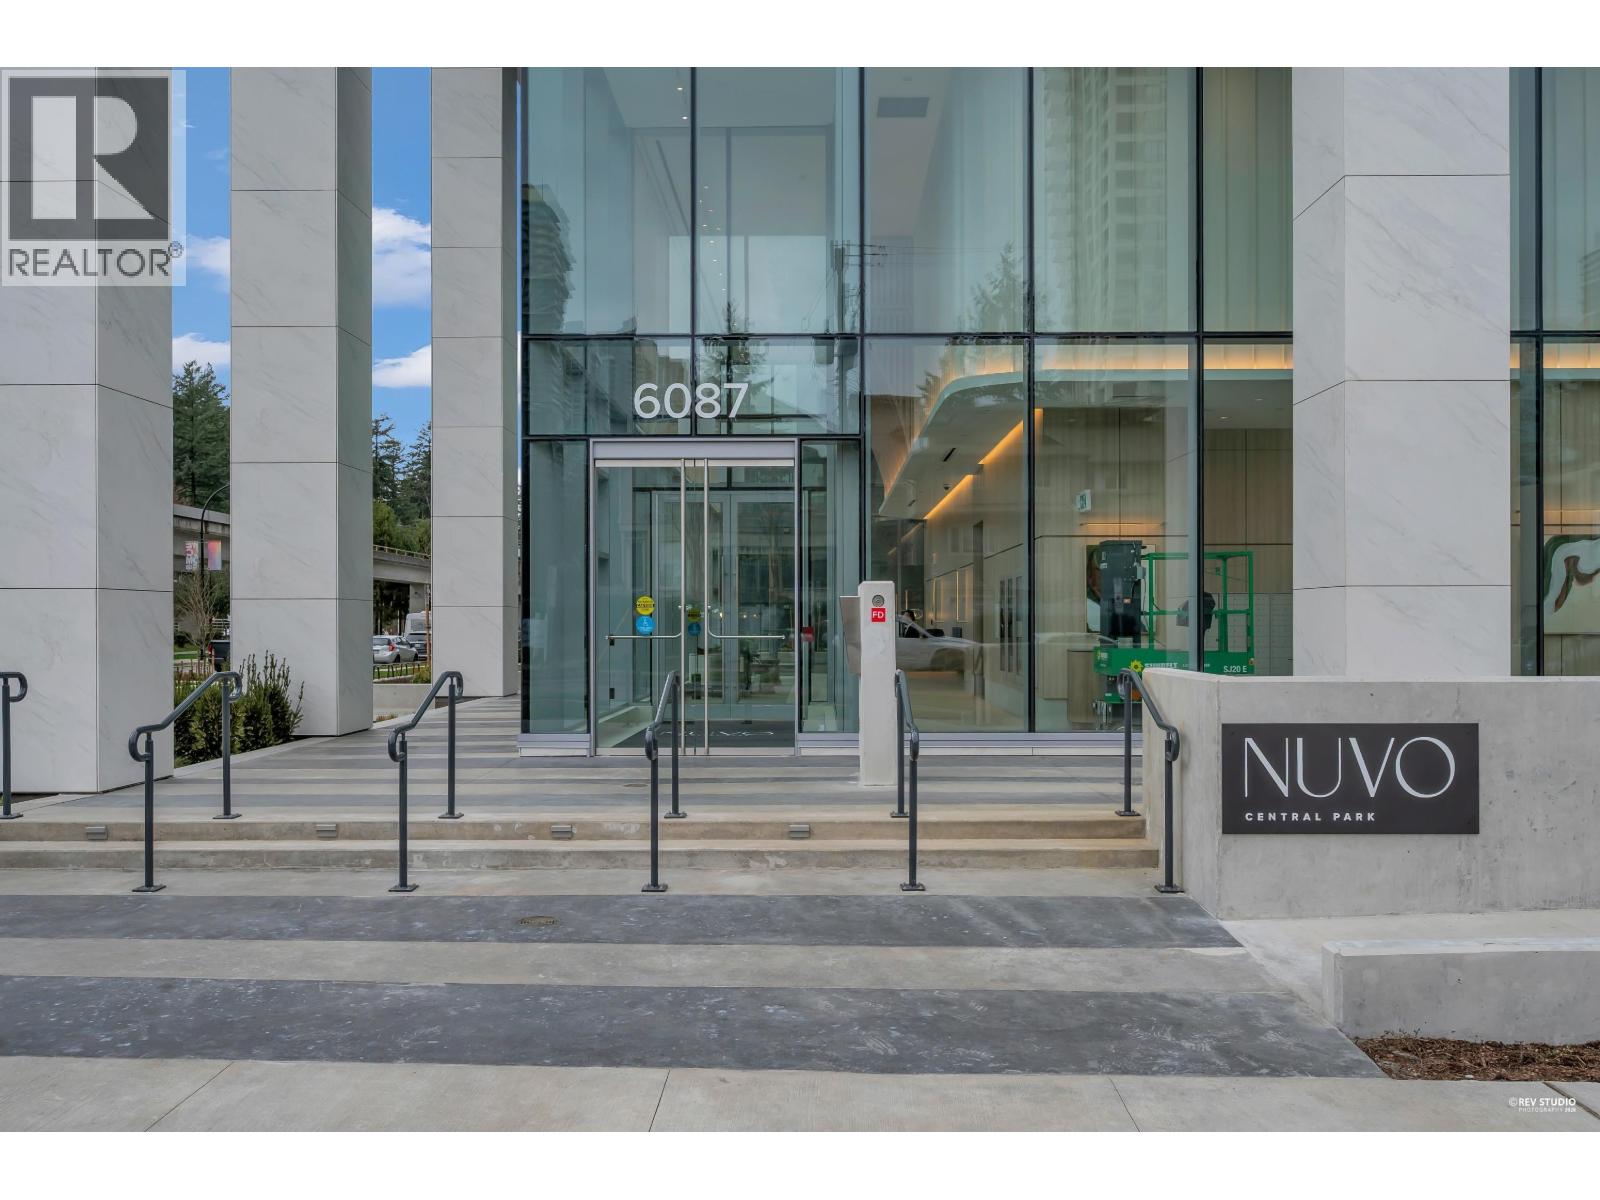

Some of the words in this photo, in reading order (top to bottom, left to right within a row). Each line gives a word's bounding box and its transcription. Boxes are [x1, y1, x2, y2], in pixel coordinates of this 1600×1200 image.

[634, 382, 749, 419] 6087
[872, 611, 885, 619] FD
[1223, 665, 1241, 673] SJ20
[1242, 665, 1248, 673] E
[1244, 736, 1456, 798] NUVO
[1245, 812, 1322, 822] CENTRAL
[1333, 812, 1376, 822] PARK
